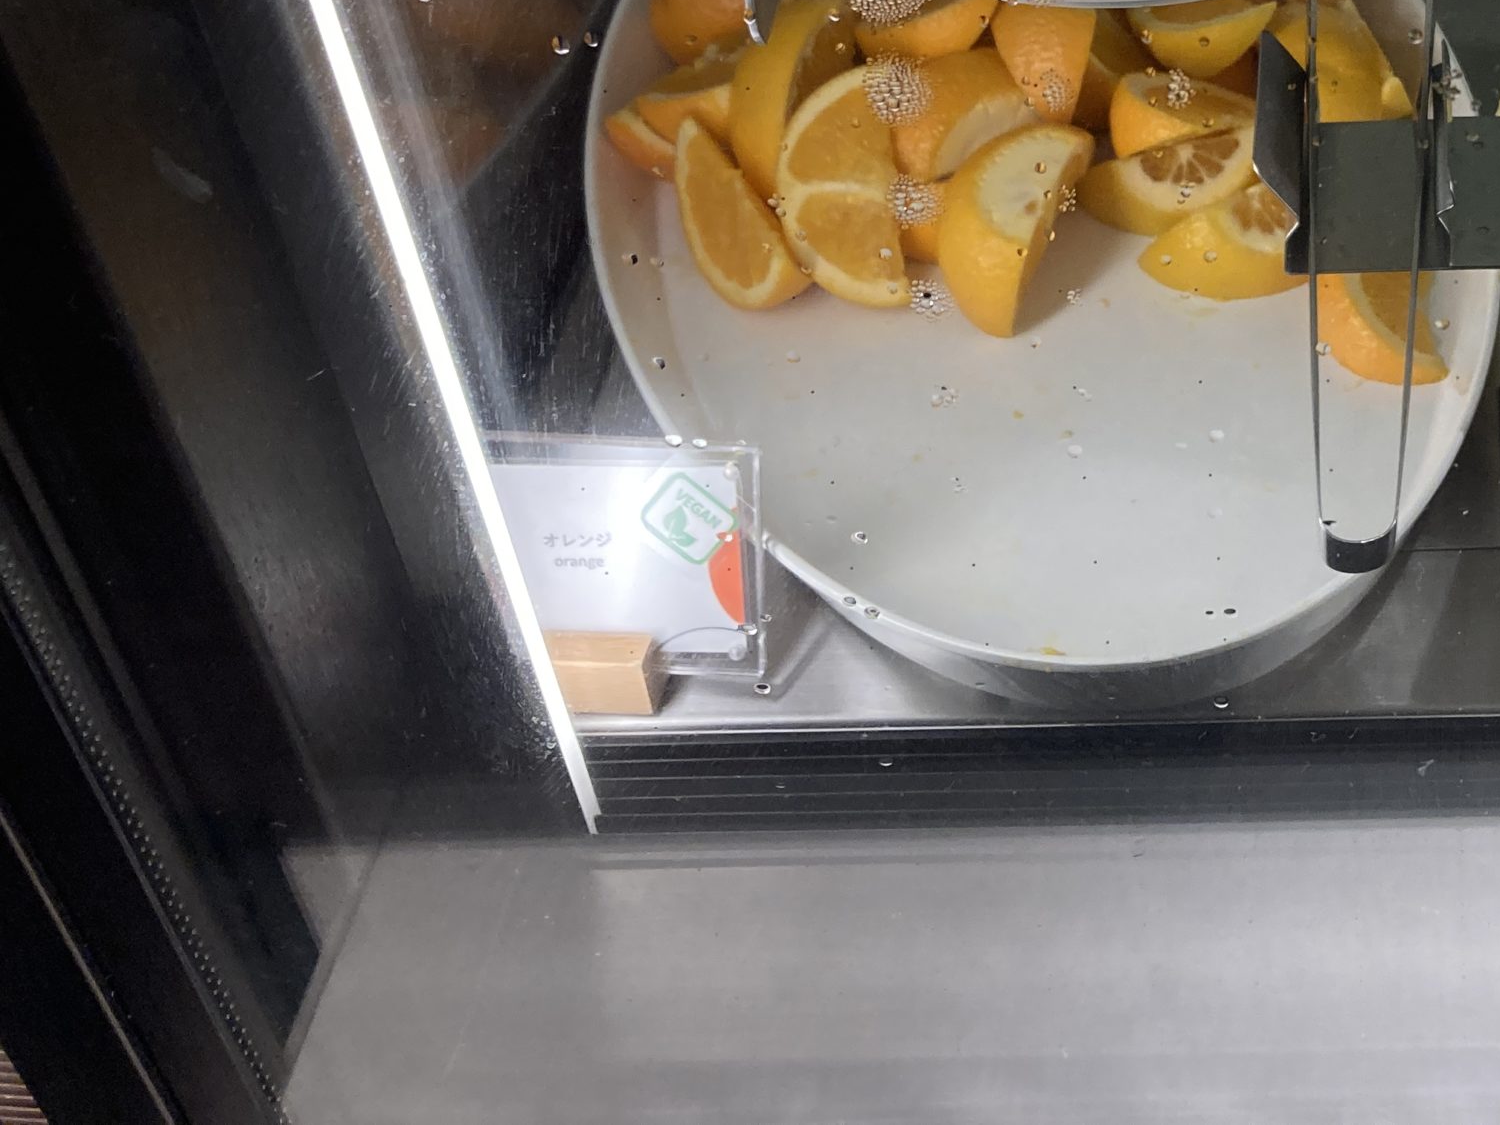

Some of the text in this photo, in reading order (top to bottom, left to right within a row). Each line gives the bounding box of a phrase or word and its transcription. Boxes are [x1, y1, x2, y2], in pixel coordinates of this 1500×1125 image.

[675, 488, 723, 529] VEGAN
[543, 531, 612, 548] オレンジ
[554, 556, 605, 570] orange
